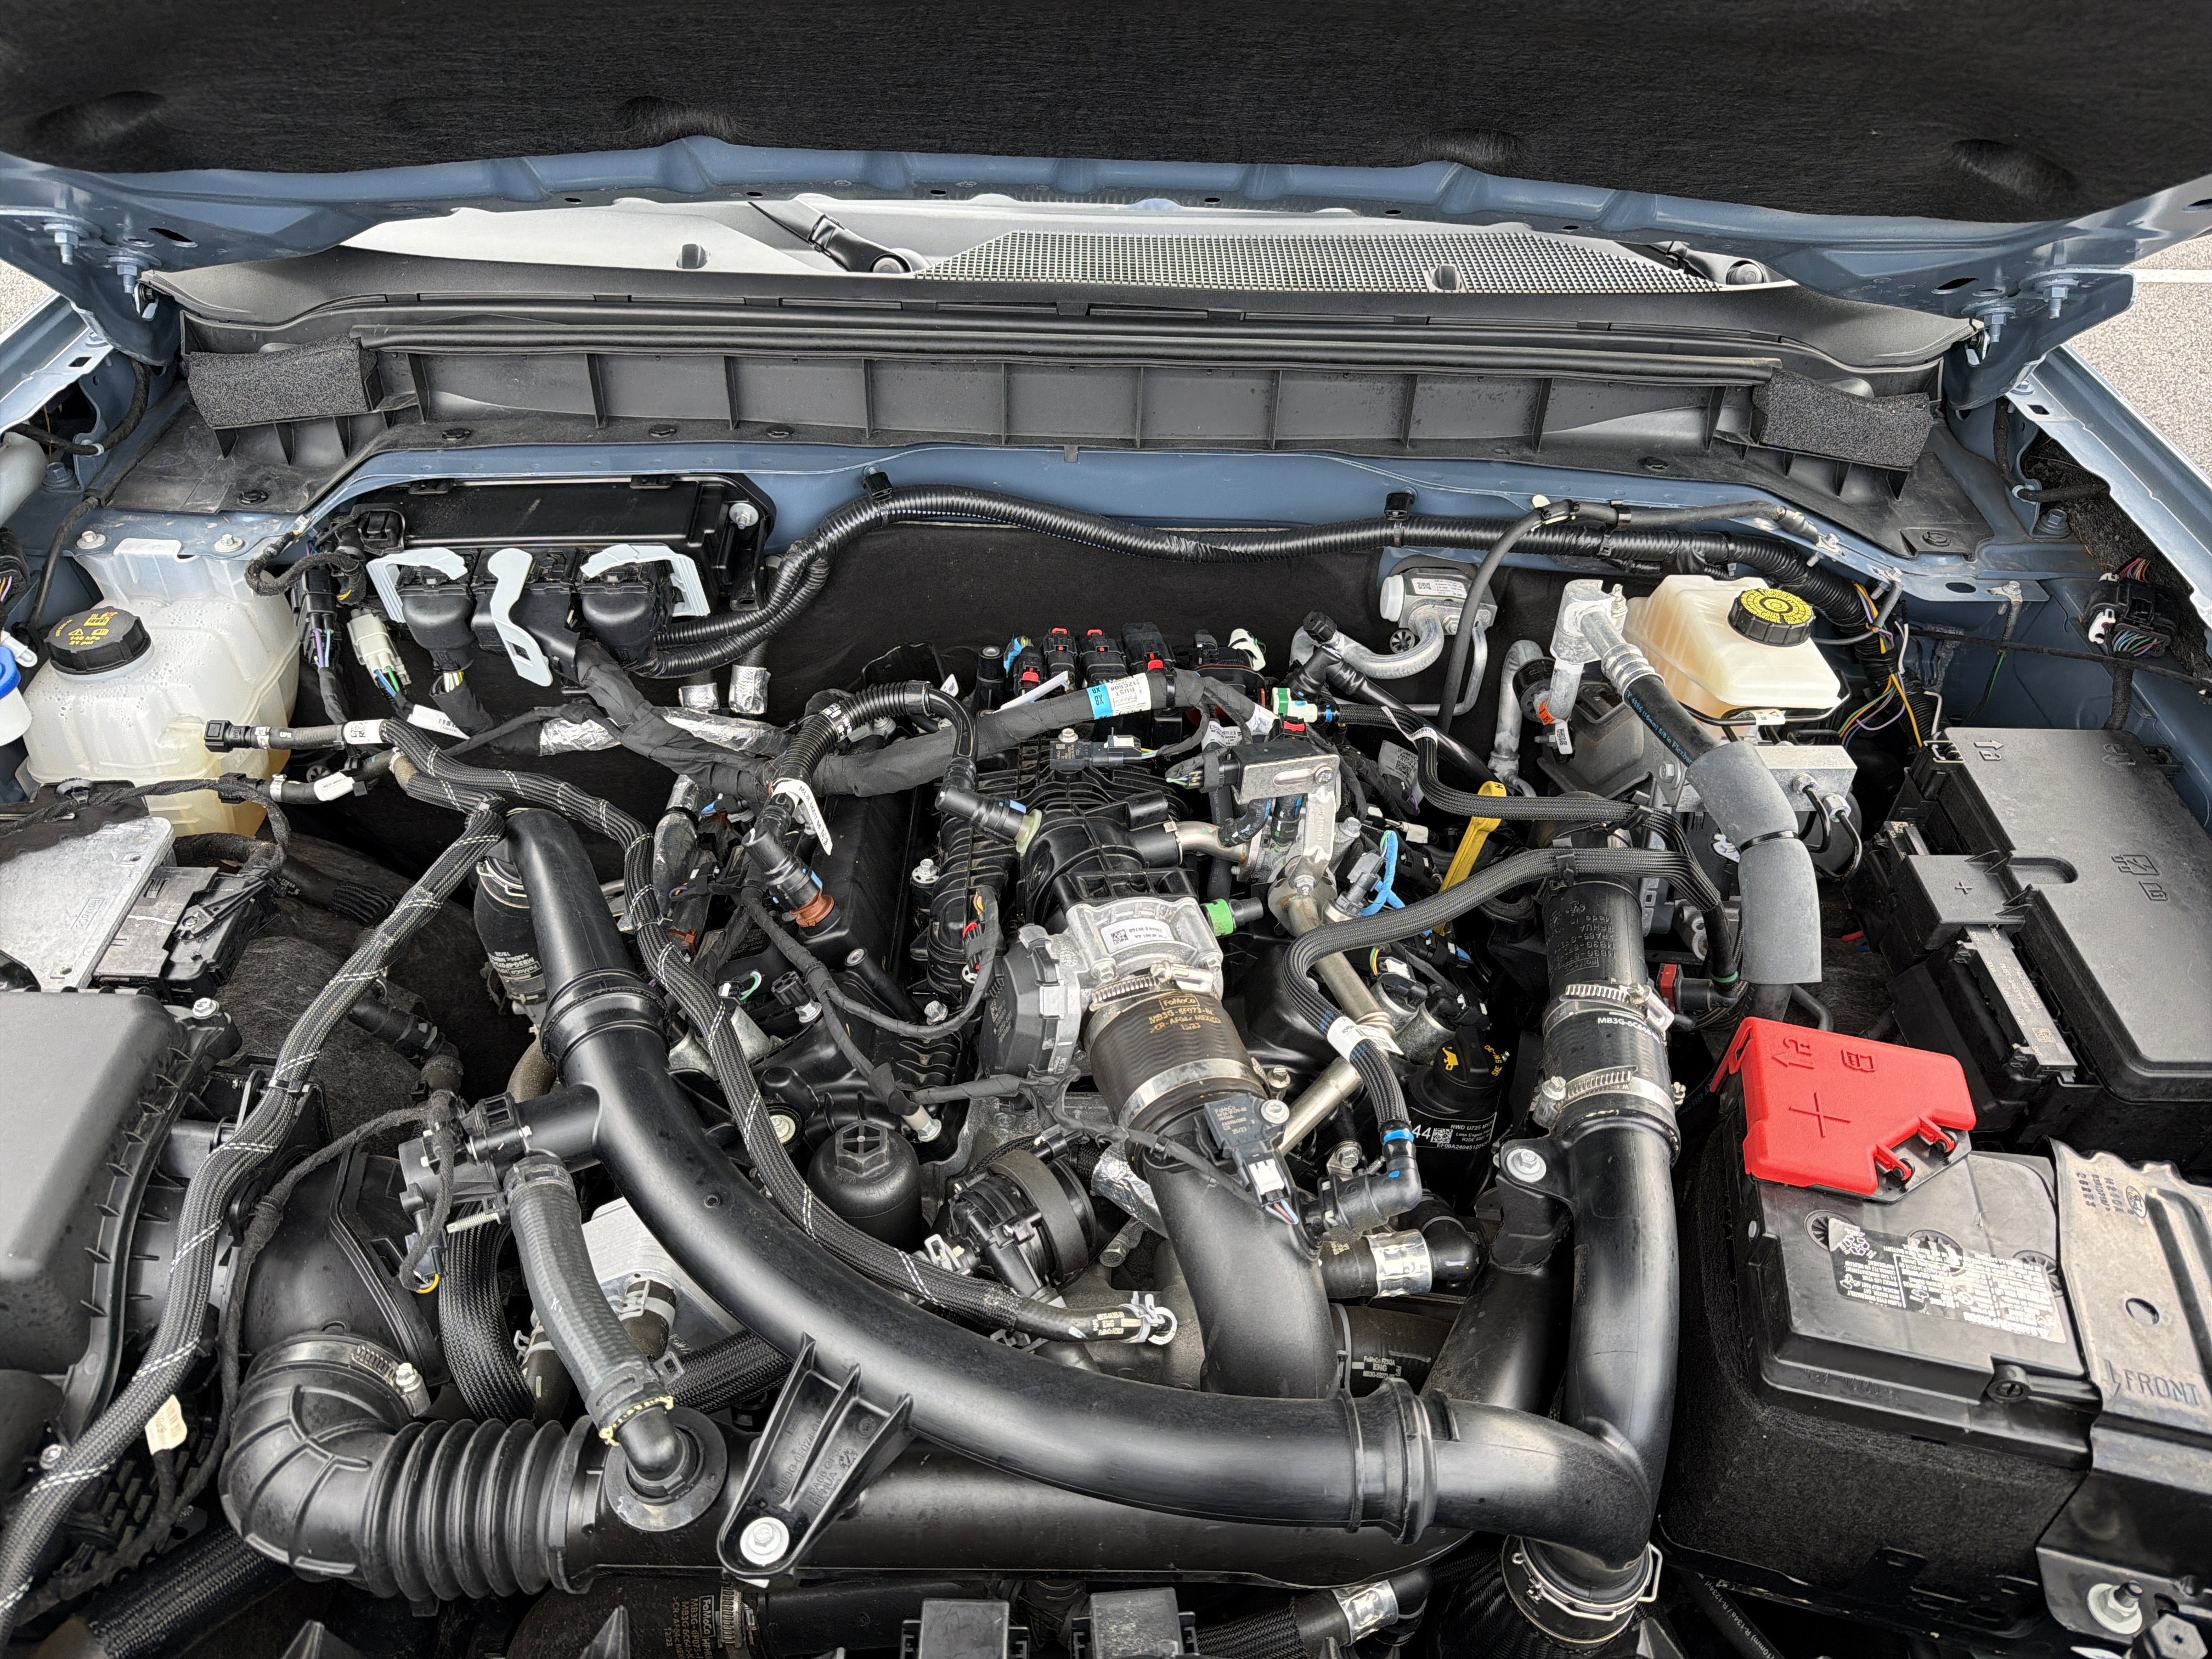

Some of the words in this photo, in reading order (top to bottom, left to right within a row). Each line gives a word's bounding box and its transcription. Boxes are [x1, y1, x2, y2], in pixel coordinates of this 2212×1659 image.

[1163, 997, 1196, 1007] FoMoCo
[1491, 1065, 1503, 1076] SAE
[1373, 1363, 1387, 1372] ENG
[2123, 1369, 2200, 1407] FRONT
[702, 1599, 712, 1635] FoMoCo
